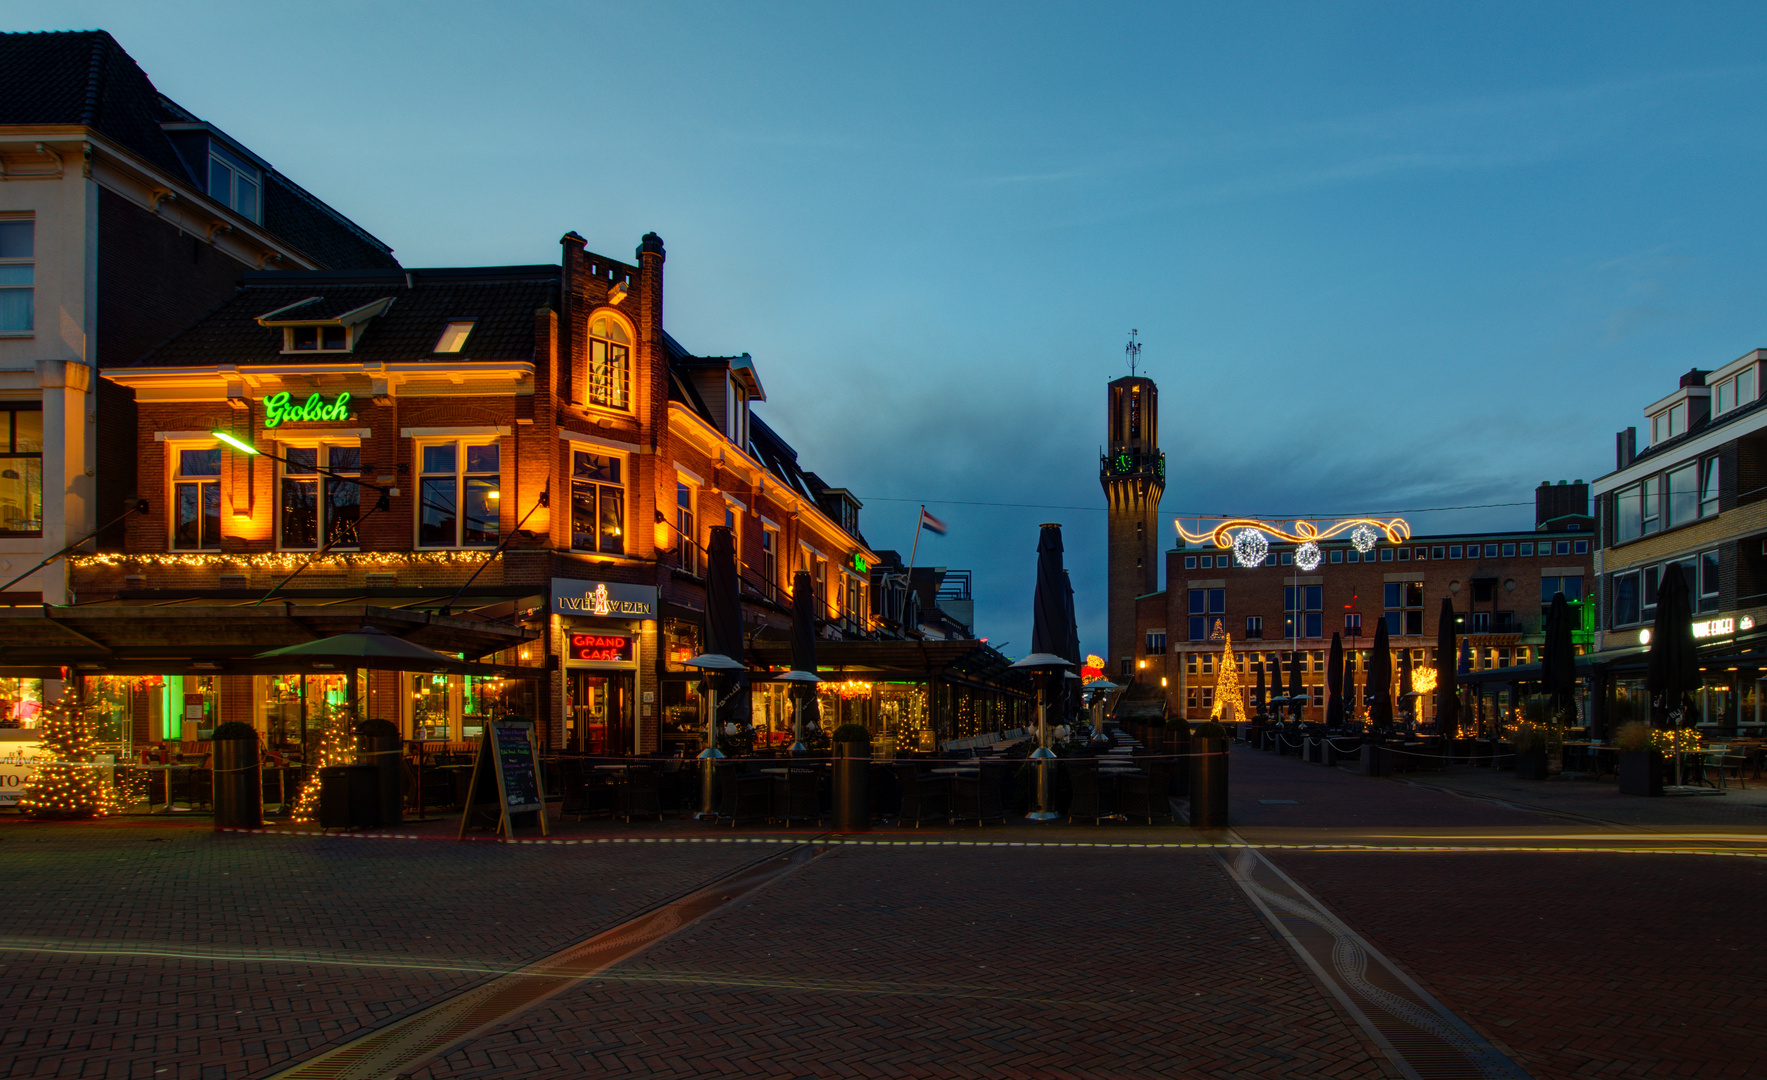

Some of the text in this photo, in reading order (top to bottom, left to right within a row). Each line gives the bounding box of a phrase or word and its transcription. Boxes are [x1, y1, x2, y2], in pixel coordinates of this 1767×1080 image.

[262, 391, 351, 428] Grolsch
[558, 597, 652, 614] TWEE WEZEN
[573, 635, 625, 648] GRAND
